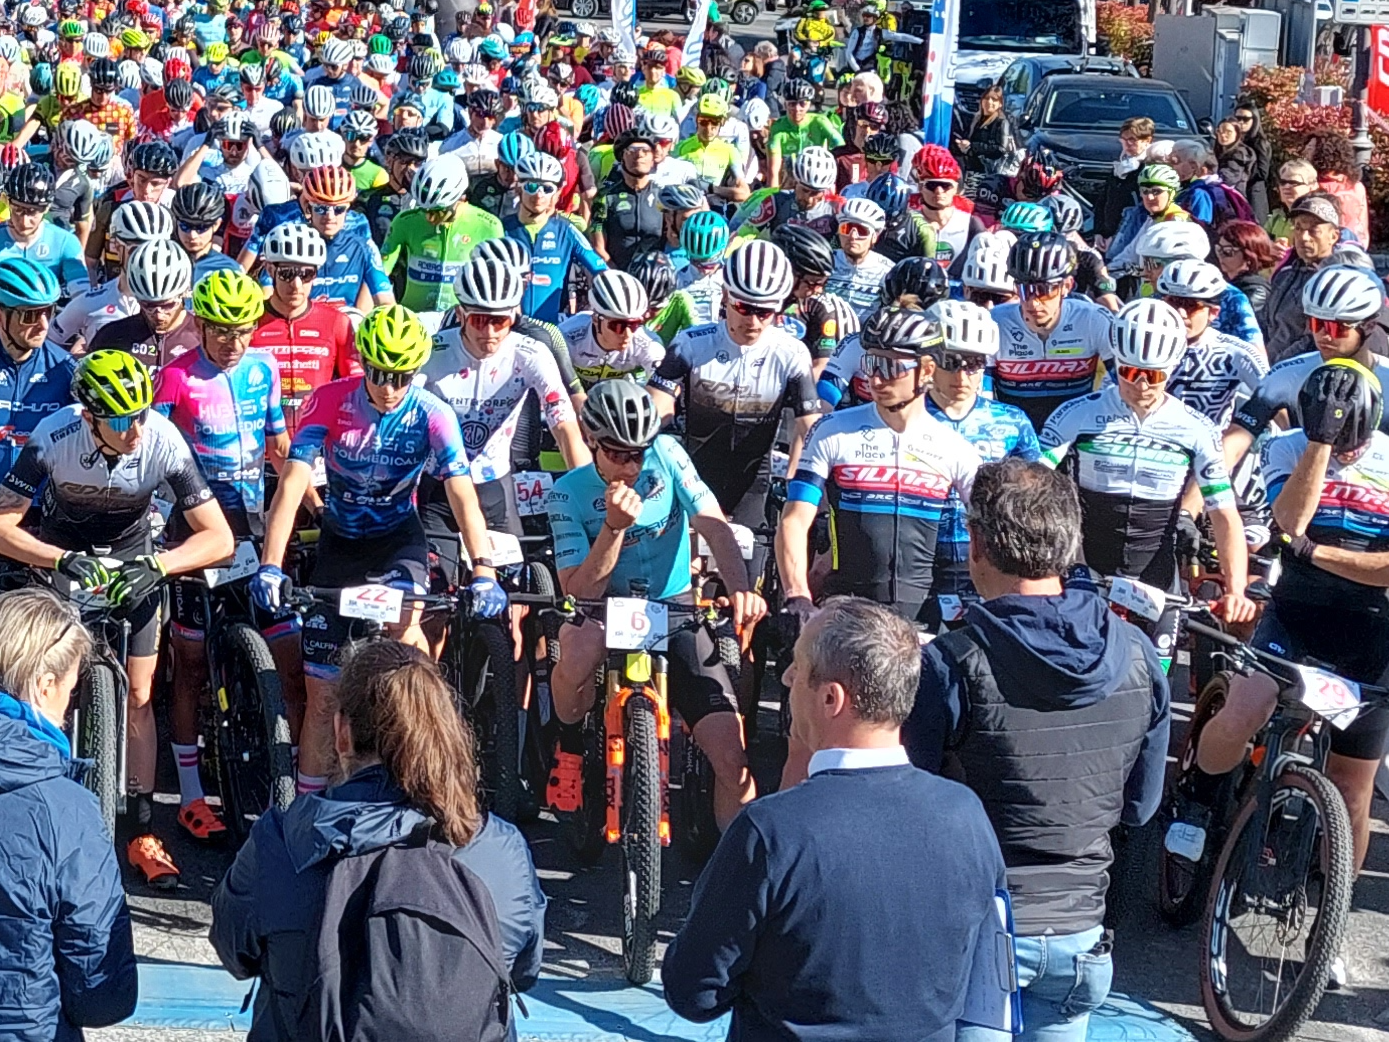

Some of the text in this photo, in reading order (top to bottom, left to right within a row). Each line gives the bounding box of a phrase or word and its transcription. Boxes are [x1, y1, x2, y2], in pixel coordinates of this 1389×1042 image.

[998, 360, 1093, 375] SILMAX
[332, 444, 421, 466] POLIMEDICAL
[861, 443, 879, 451] The
[839, 466, 949, 492] SILMAX
[516, 479, 544, 502] 54
[357, 587, 389, 603] 22
[631, 611, 646, 631] 6
[1316, 677, 1347, 706] 29
